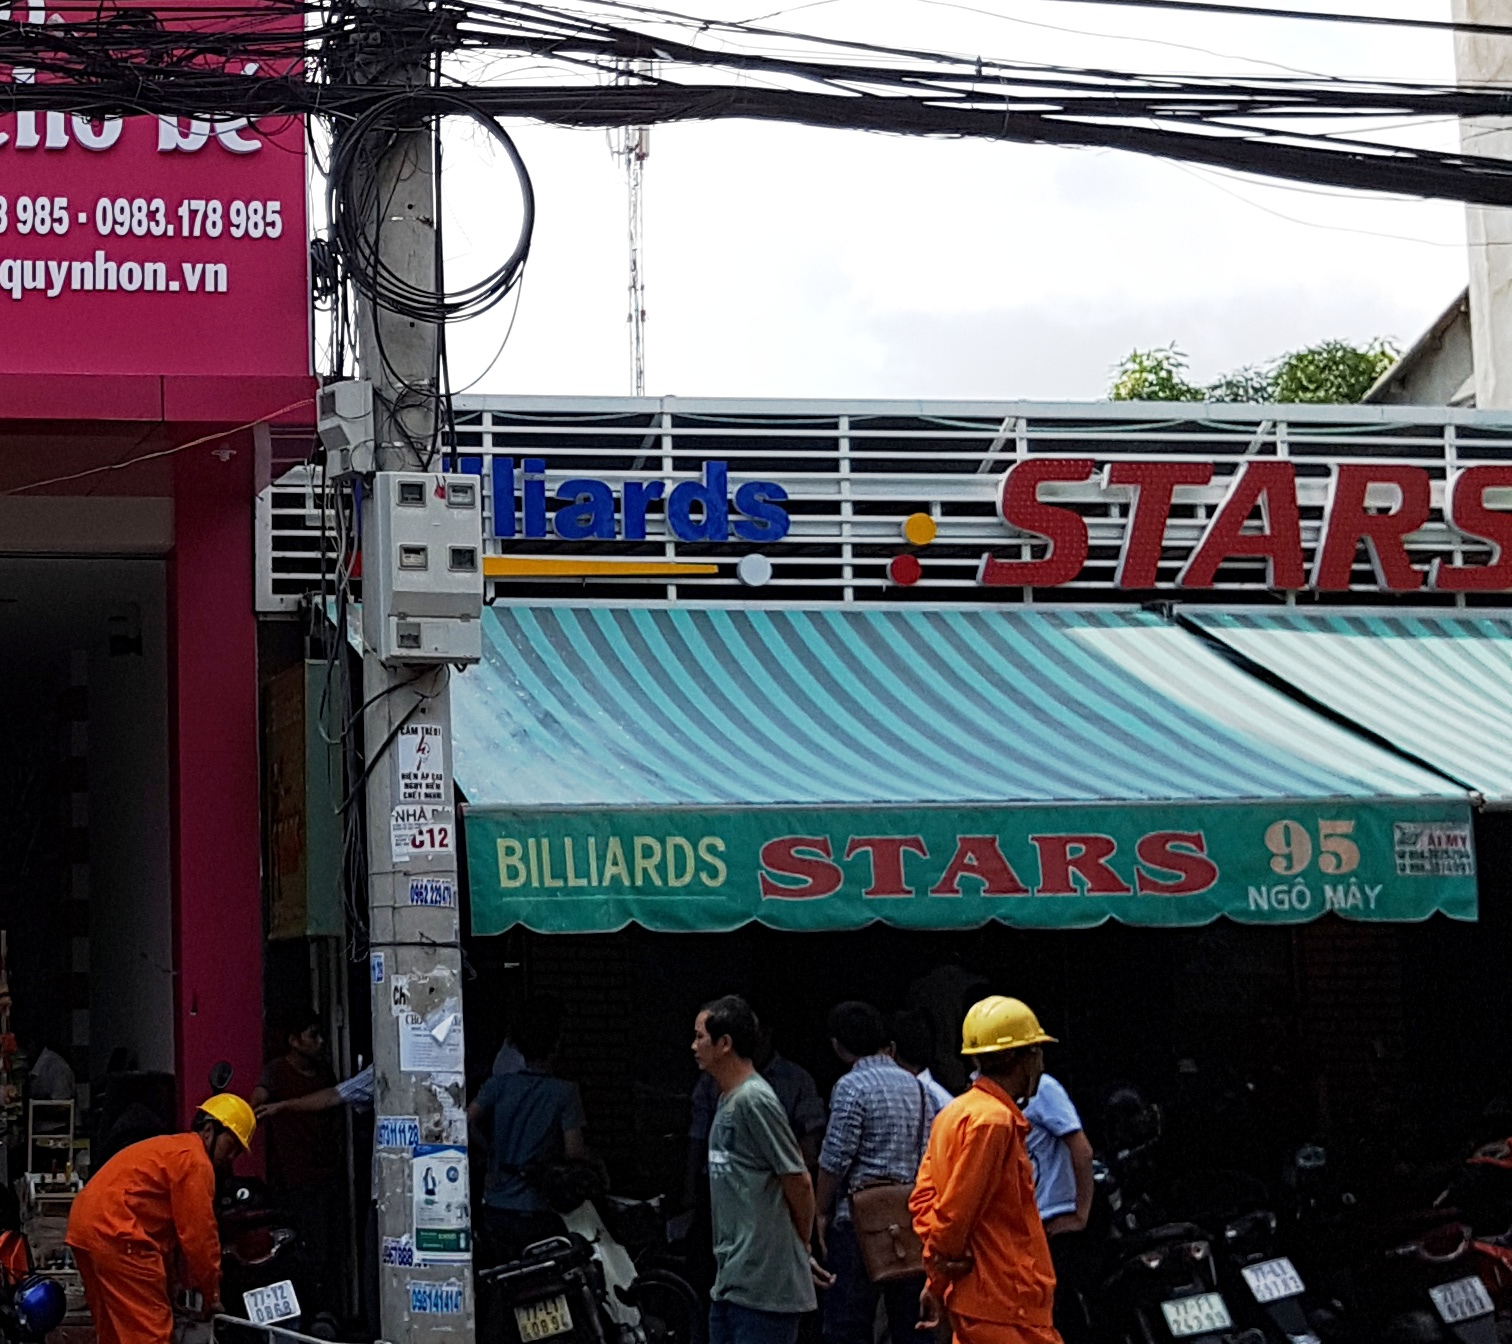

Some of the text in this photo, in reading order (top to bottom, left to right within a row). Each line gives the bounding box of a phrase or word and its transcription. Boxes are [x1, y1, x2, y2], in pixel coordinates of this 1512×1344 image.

[16, 196, 69, 235] 985
[95, 197, 223, 238] 0983.178
[229, 200, 283, 238] 985
[977, 458, 1512, 592] STARS
[496, 819, 1362, 899] BILLIARDS STARS 95
[1247, 877, 1384, 911] NGÔ MÂY
